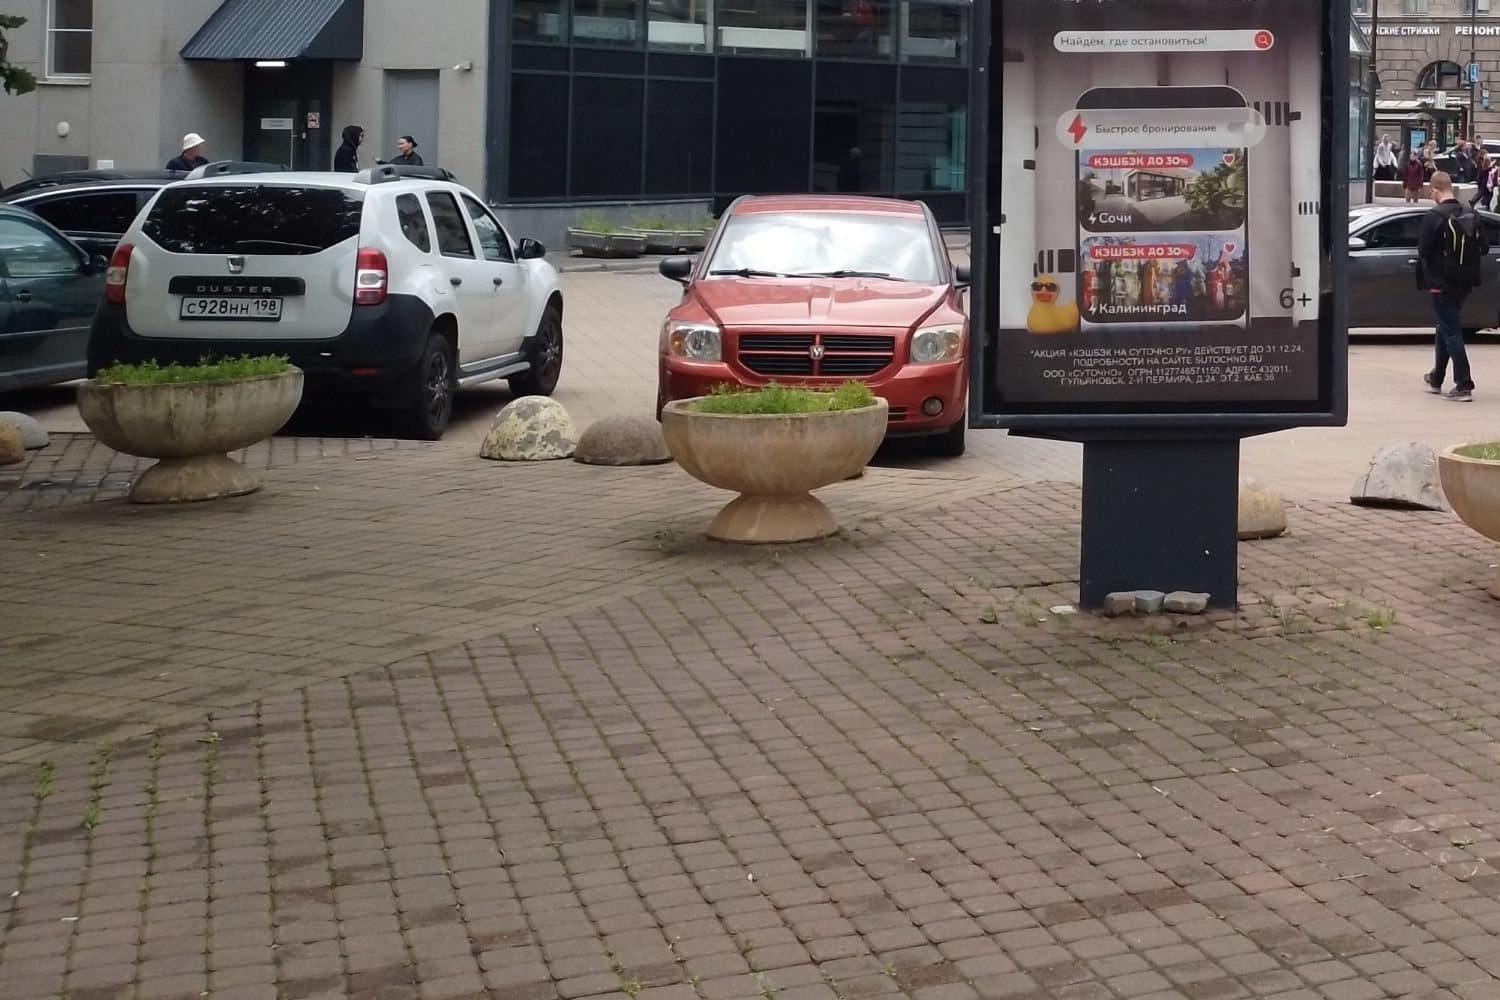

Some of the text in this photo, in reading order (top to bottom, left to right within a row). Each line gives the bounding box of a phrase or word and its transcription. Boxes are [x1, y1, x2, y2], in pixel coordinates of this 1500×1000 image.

[1360, 25, 1400, 36] МУСКИЕ
[1109, 38, 1128, 47] где
[1131, 35, 1208, 46] остановиться!
[1095, 123, 1217, 136] Быстрое бронирование
[1094, 156, 1189, 167] КЭШБЭК ДО 30%
[1099, 212, 1132, 224] Сочи
[1095, 246, 1145, 257] КЭШБЭК
[1147, 246, 1164, 256] ДО
[197, 285, 273, 293] DUSTER
[1280, 288, 1312, 309] 6+
[254, 300, 277, 311] 198
[1099, 303, 1188, 316] Калининград
